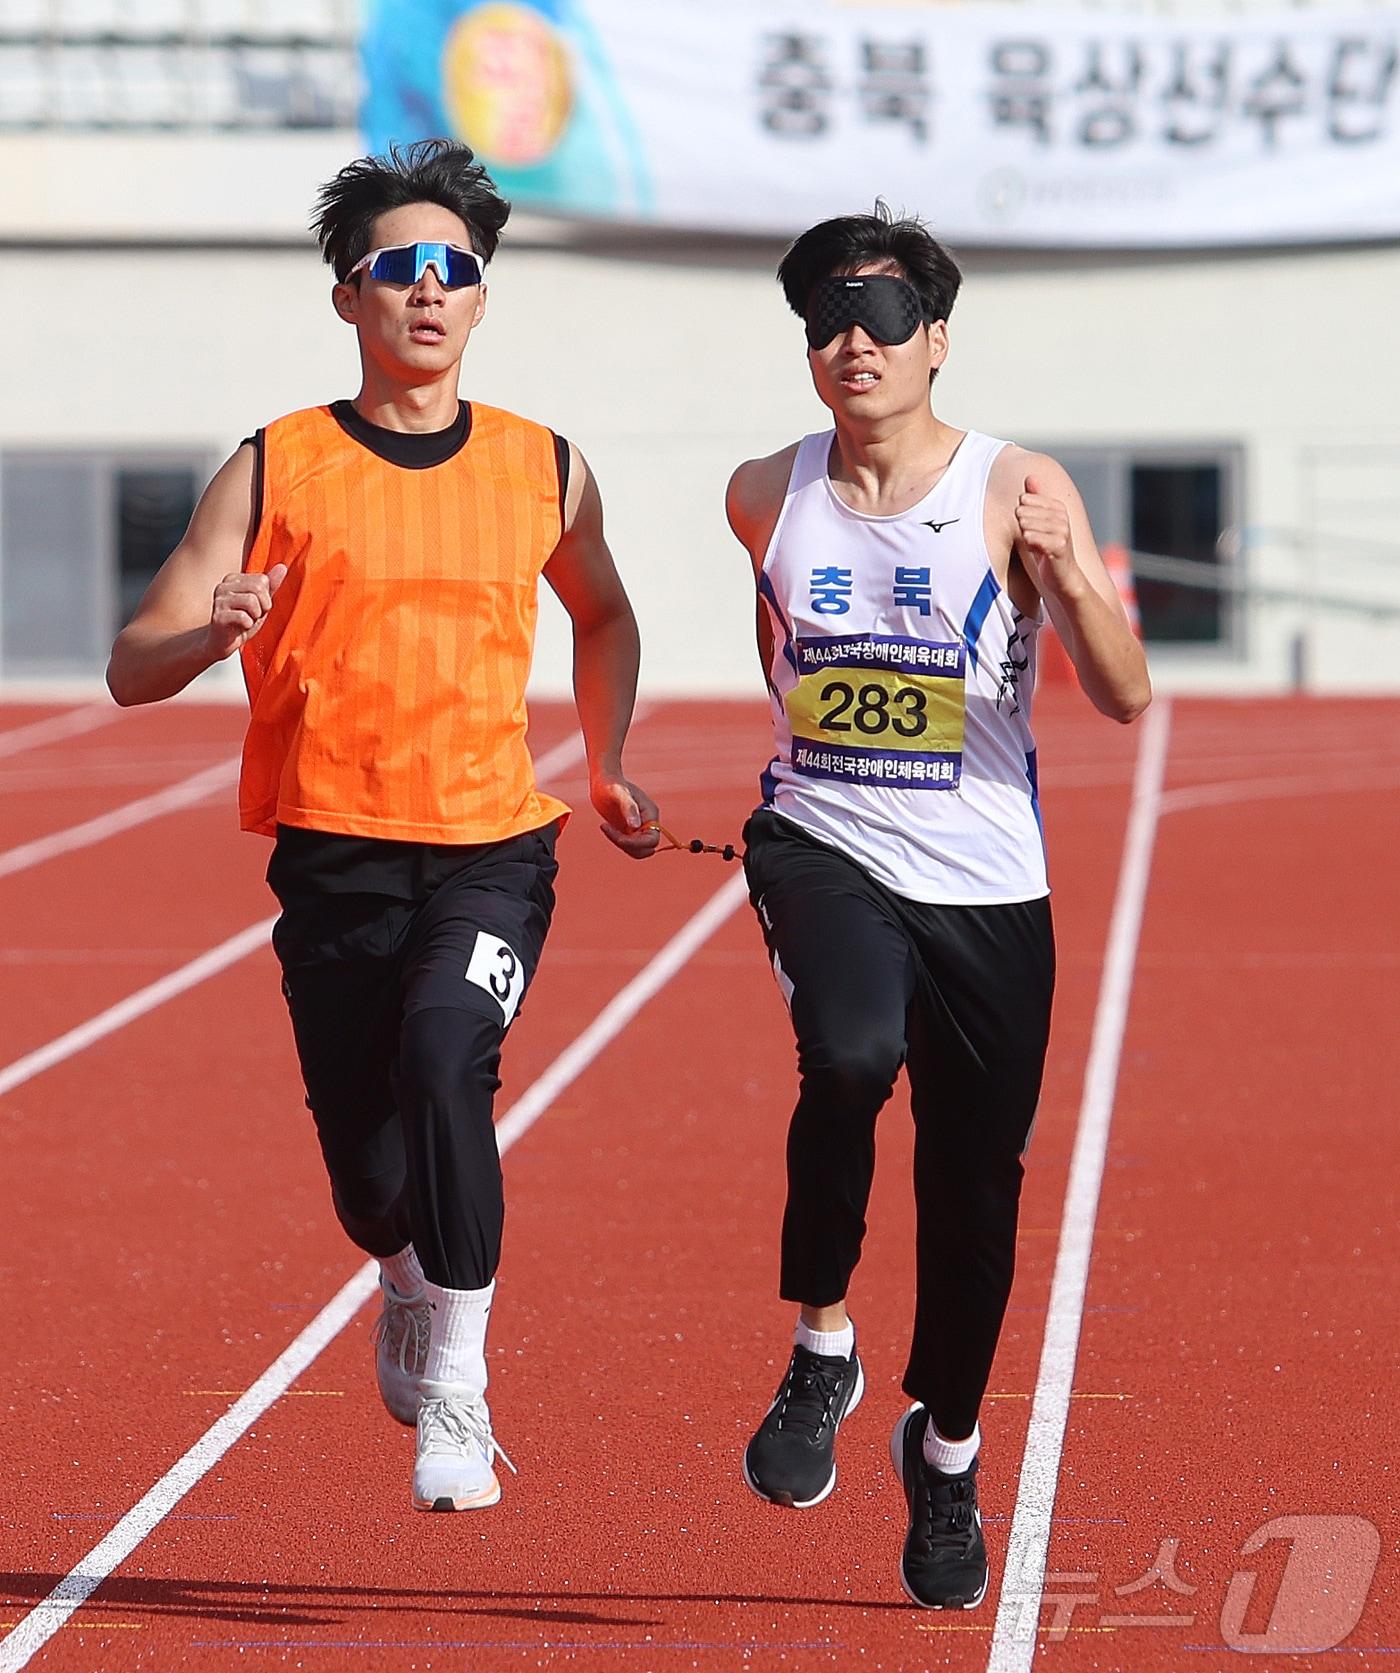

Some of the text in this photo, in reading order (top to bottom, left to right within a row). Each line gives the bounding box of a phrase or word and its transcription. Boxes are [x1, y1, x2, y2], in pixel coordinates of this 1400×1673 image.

[758, 31, 1400, 148] 충북 육상선수단
[818, 681, 928, 738] 283
[796, 748, 955, 782] 제44회전국장애인체육대회
[489, 946, 517, 1002] 3
